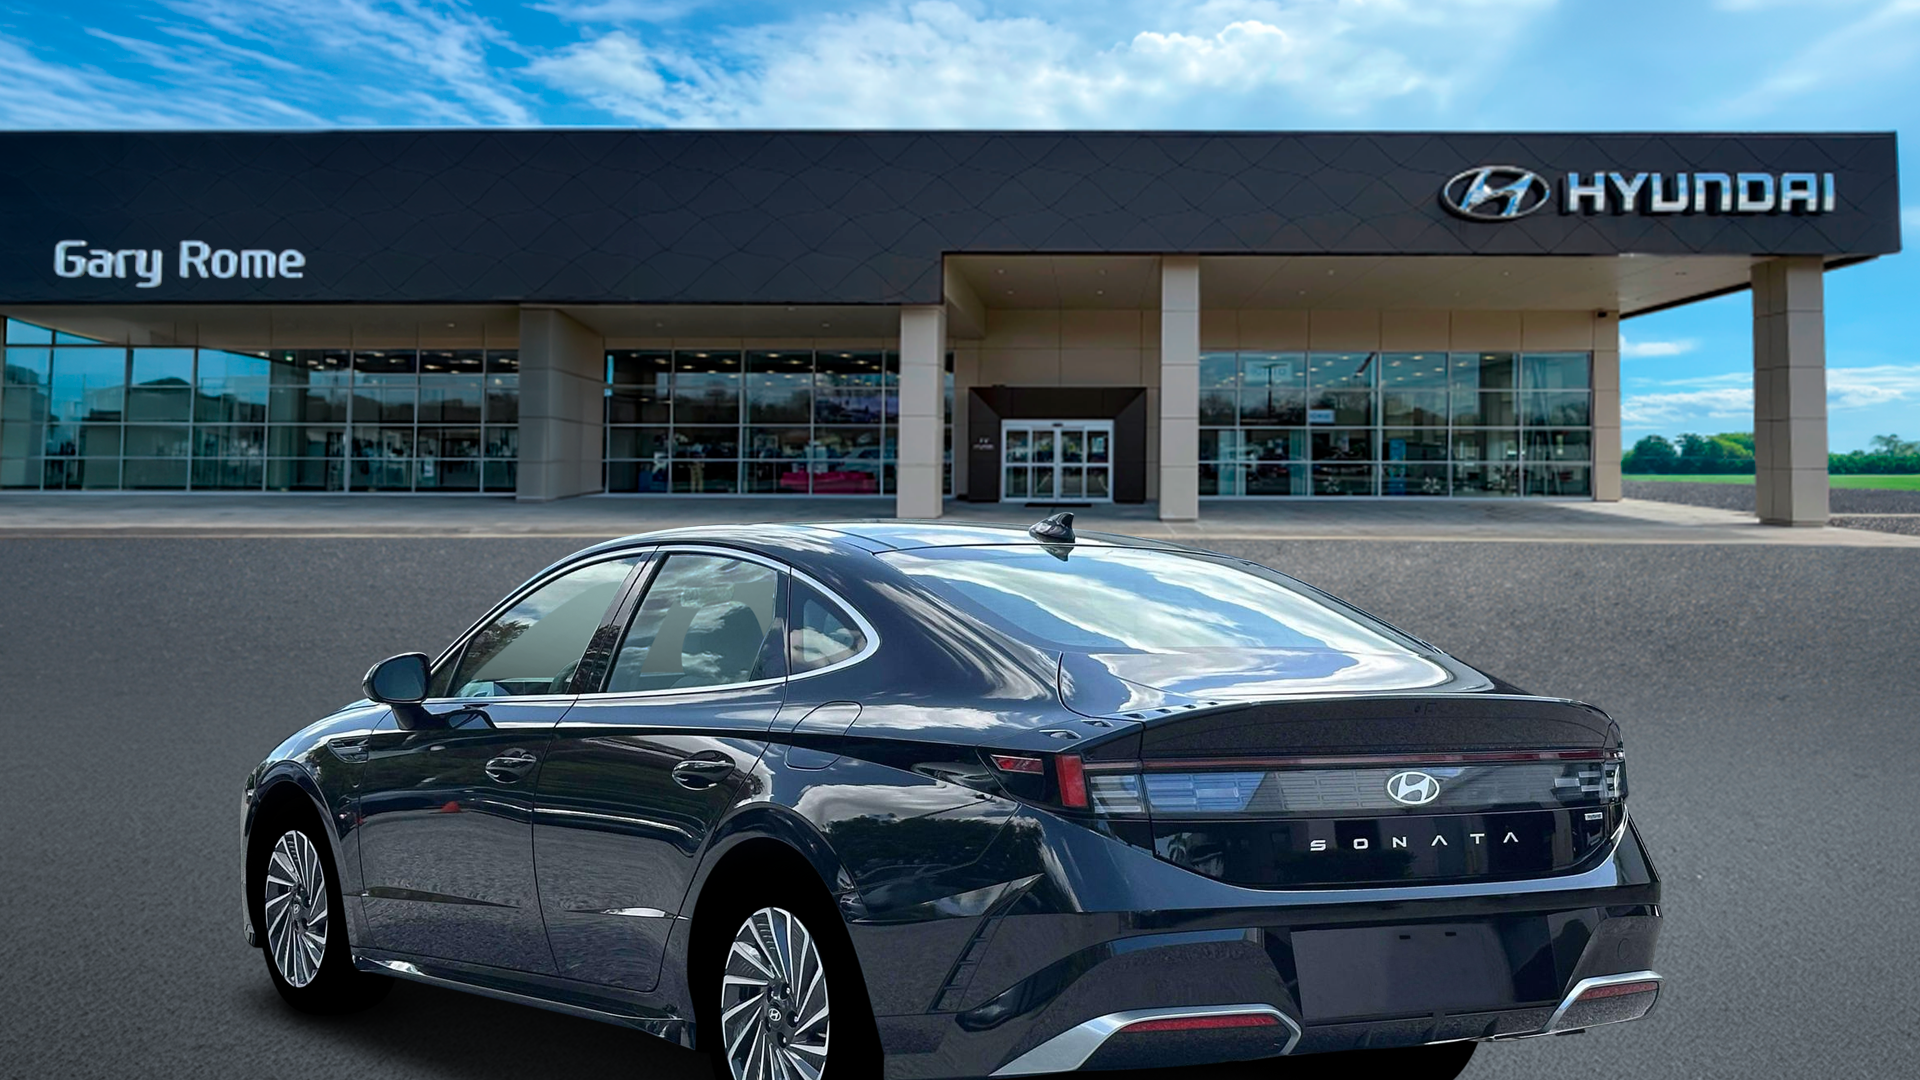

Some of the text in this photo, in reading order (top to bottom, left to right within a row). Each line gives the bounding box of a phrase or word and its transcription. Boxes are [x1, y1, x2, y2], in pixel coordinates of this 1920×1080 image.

[1566, 172, 1836, 213] HYUNDAI
[53, 239, 306, 289] Gary Rome
[1310, 831, 1519, 851] SONATA
